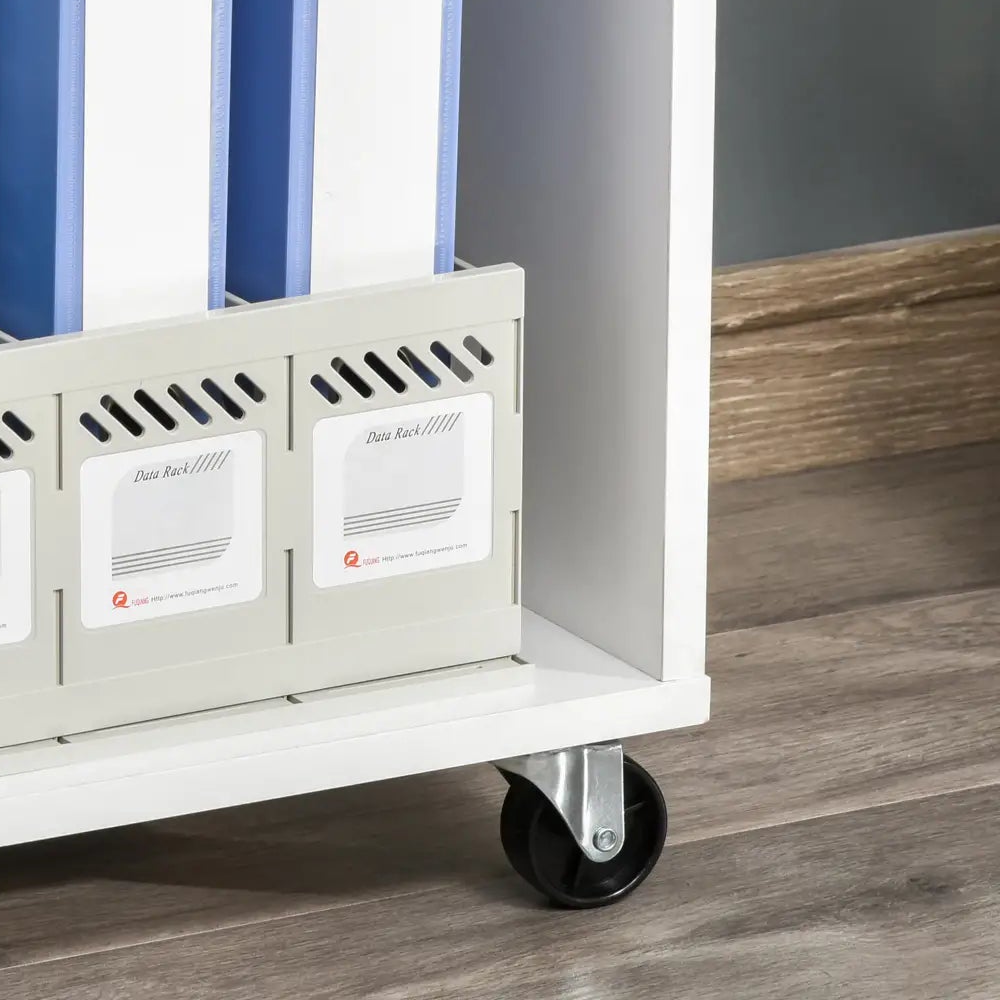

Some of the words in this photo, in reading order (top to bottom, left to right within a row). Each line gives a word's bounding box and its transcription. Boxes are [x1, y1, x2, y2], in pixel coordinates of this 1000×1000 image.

[366, 430, 391, 444] Data
[394, 423, 421, 440] Rack
[134, 469, 159, 483] Data
[162, 462, 190, 479] Rack
